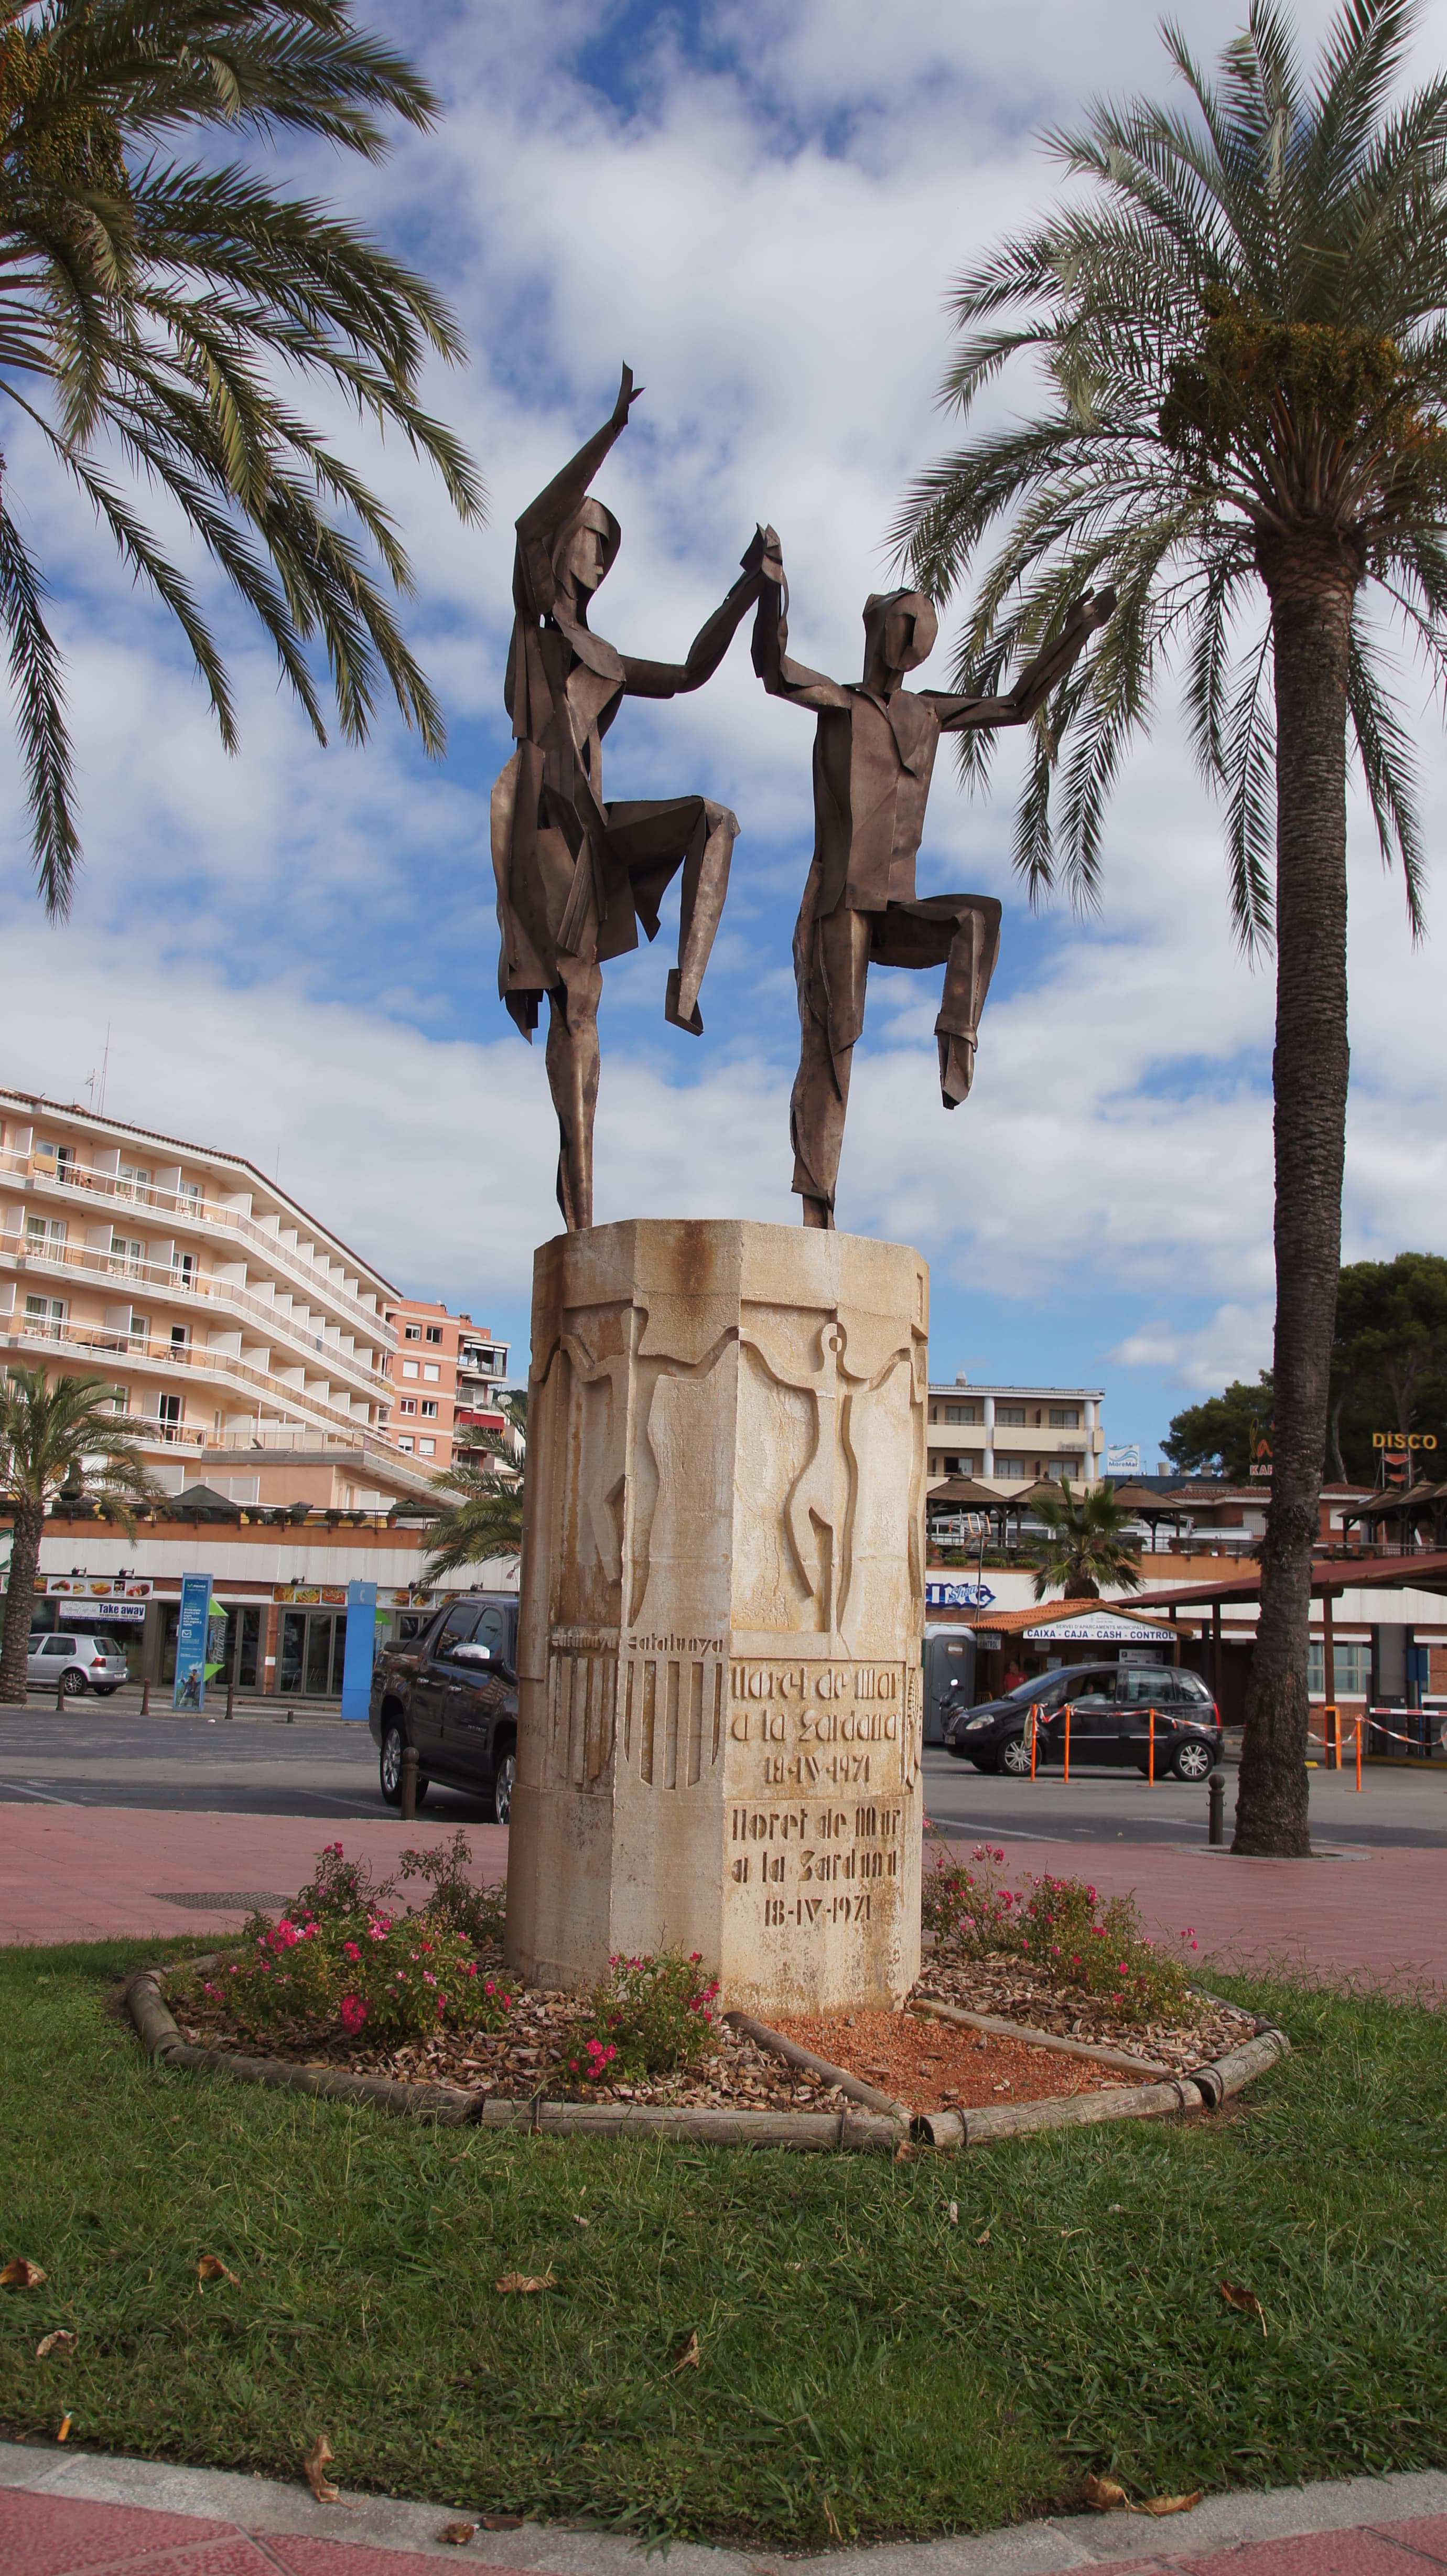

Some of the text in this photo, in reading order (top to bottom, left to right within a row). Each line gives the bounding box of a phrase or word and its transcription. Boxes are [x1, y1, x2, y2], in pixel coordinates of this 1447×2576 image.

[1373, 1432, 1437, 1450] DISCO
[99, 1604, 119, 1614] Take
[121, 1606, 144, 1616] away
[1027, 1629, 1056, 1637] CAIXA
[1130, 1631, 1174, 1639] CONTROL
[817, 1668, 847, 1699] de
[732, 1712, 749, 1741] a
[763, 1709, 785, 1741] la
[816, 1808, 847, 1839] de
[731, 1849, 897, 1883] a la Sardana
[764, 1894, 870, 1926] 18-IV-1971
